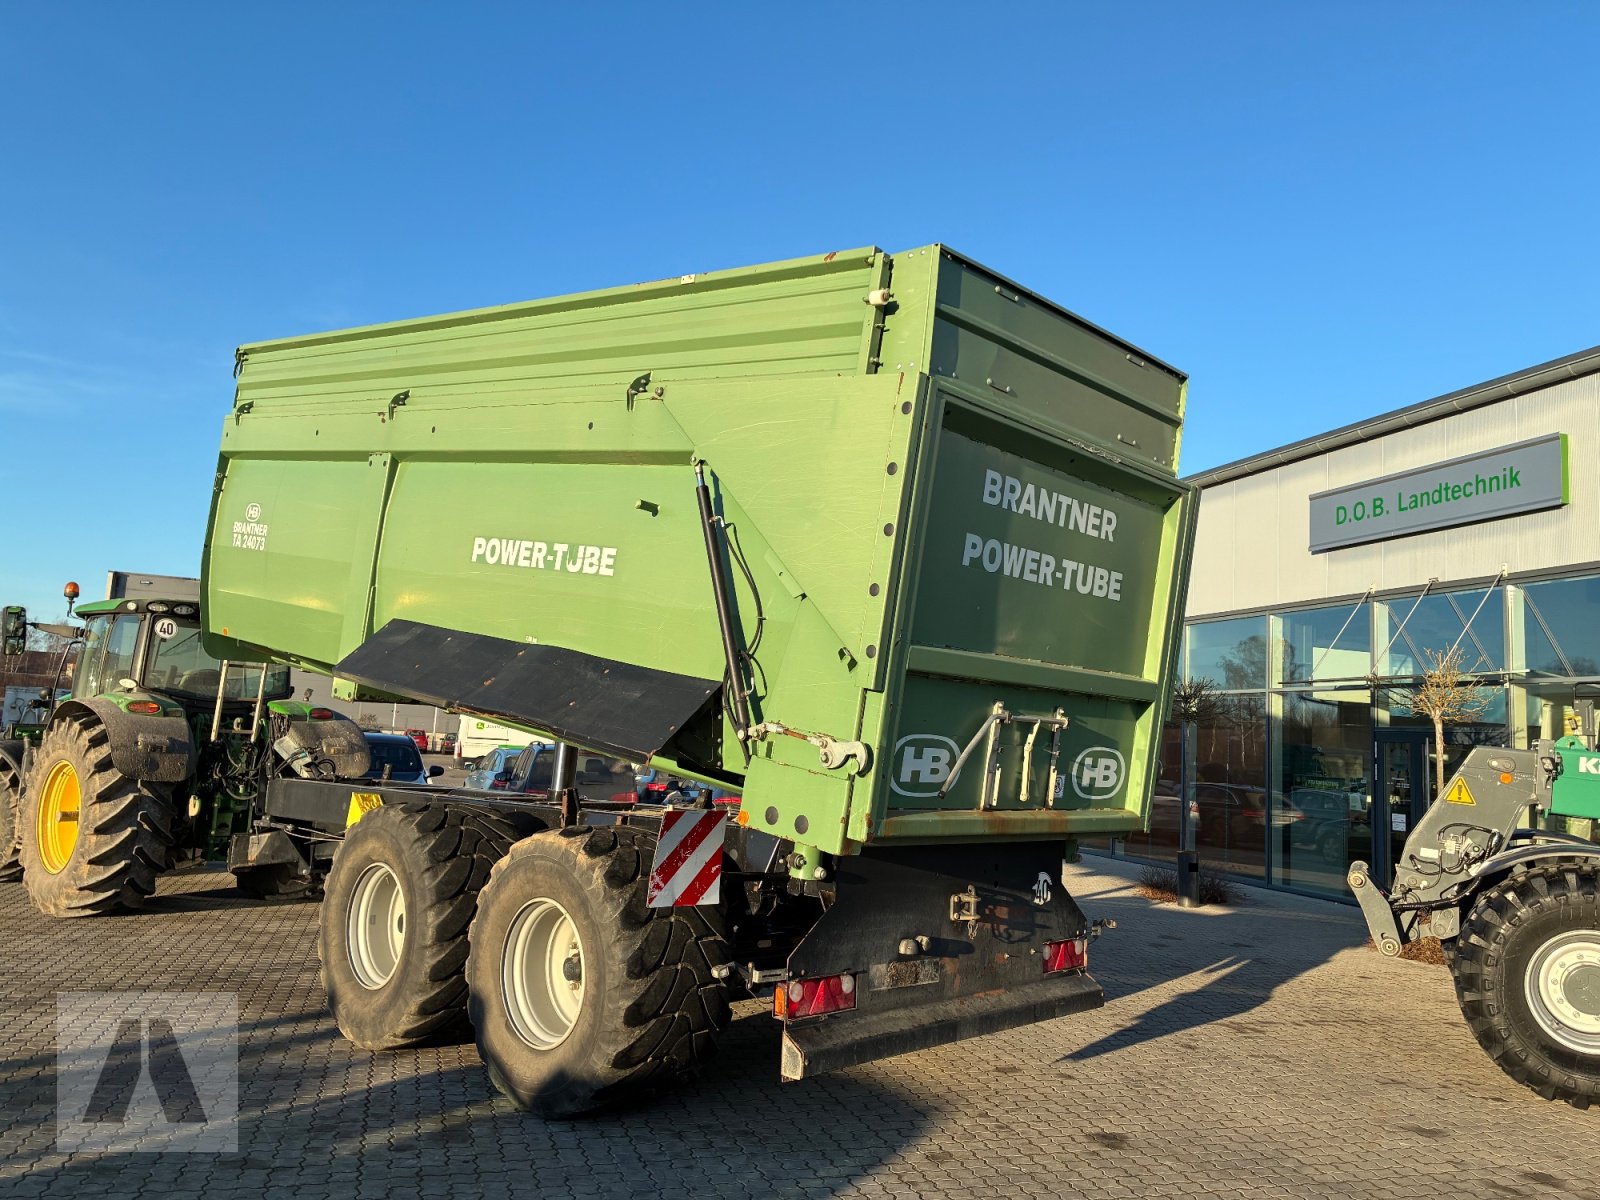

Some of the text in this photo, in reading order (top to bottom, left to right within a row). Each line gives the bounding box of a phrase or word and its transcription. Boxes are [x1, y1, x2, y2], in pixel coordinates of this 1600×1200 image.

[982, 468, 1118, 542] BRANTNER
[1335, 466, 1521, 525] D.O.B. Landtechnik
[232, 521, 268, 537] BRANTNER
[471, 537, 618, 577] POWER-TUBE
[962, 532, 1123, 601] POWER-TUBE
[159, 622, 174, 636] 40
[899, 746, 951, 783] HB
[1081, 757, 1118, 788] HB
[1578, 756, 1600, 774] K
